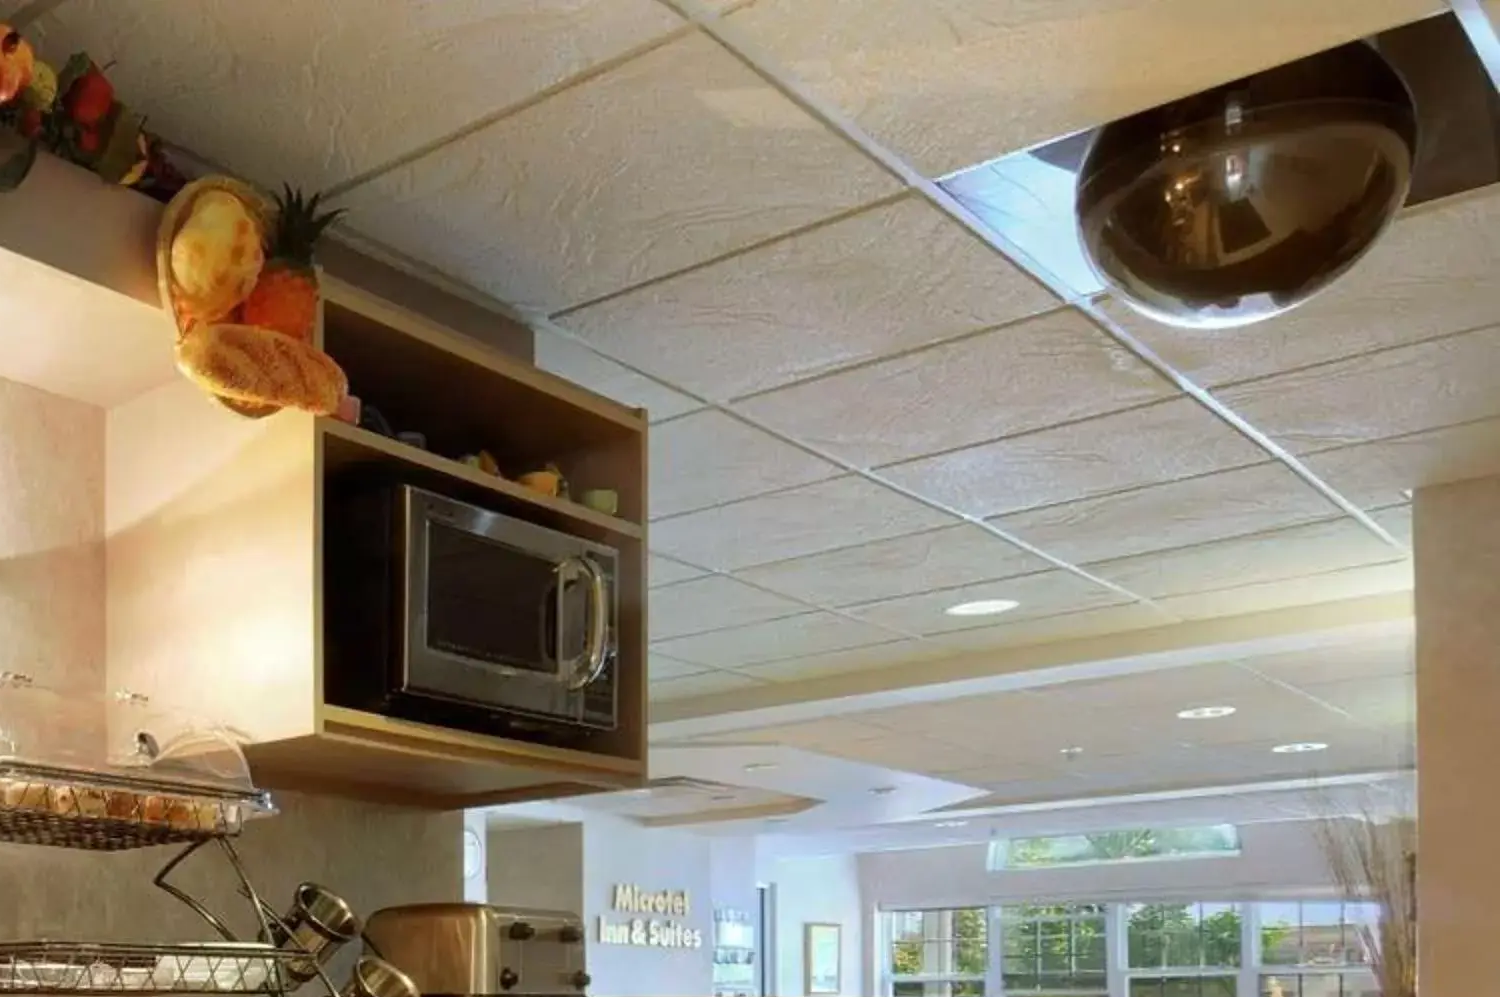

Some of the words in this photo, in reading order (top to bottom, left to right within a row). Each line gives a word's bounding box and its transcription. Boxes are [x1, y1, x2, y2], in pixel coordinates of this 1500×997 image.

[611, 882, 690, 916] Microtel
[597, 914, 629, 944] Inn
[649, 920, 702, 948] Suites
